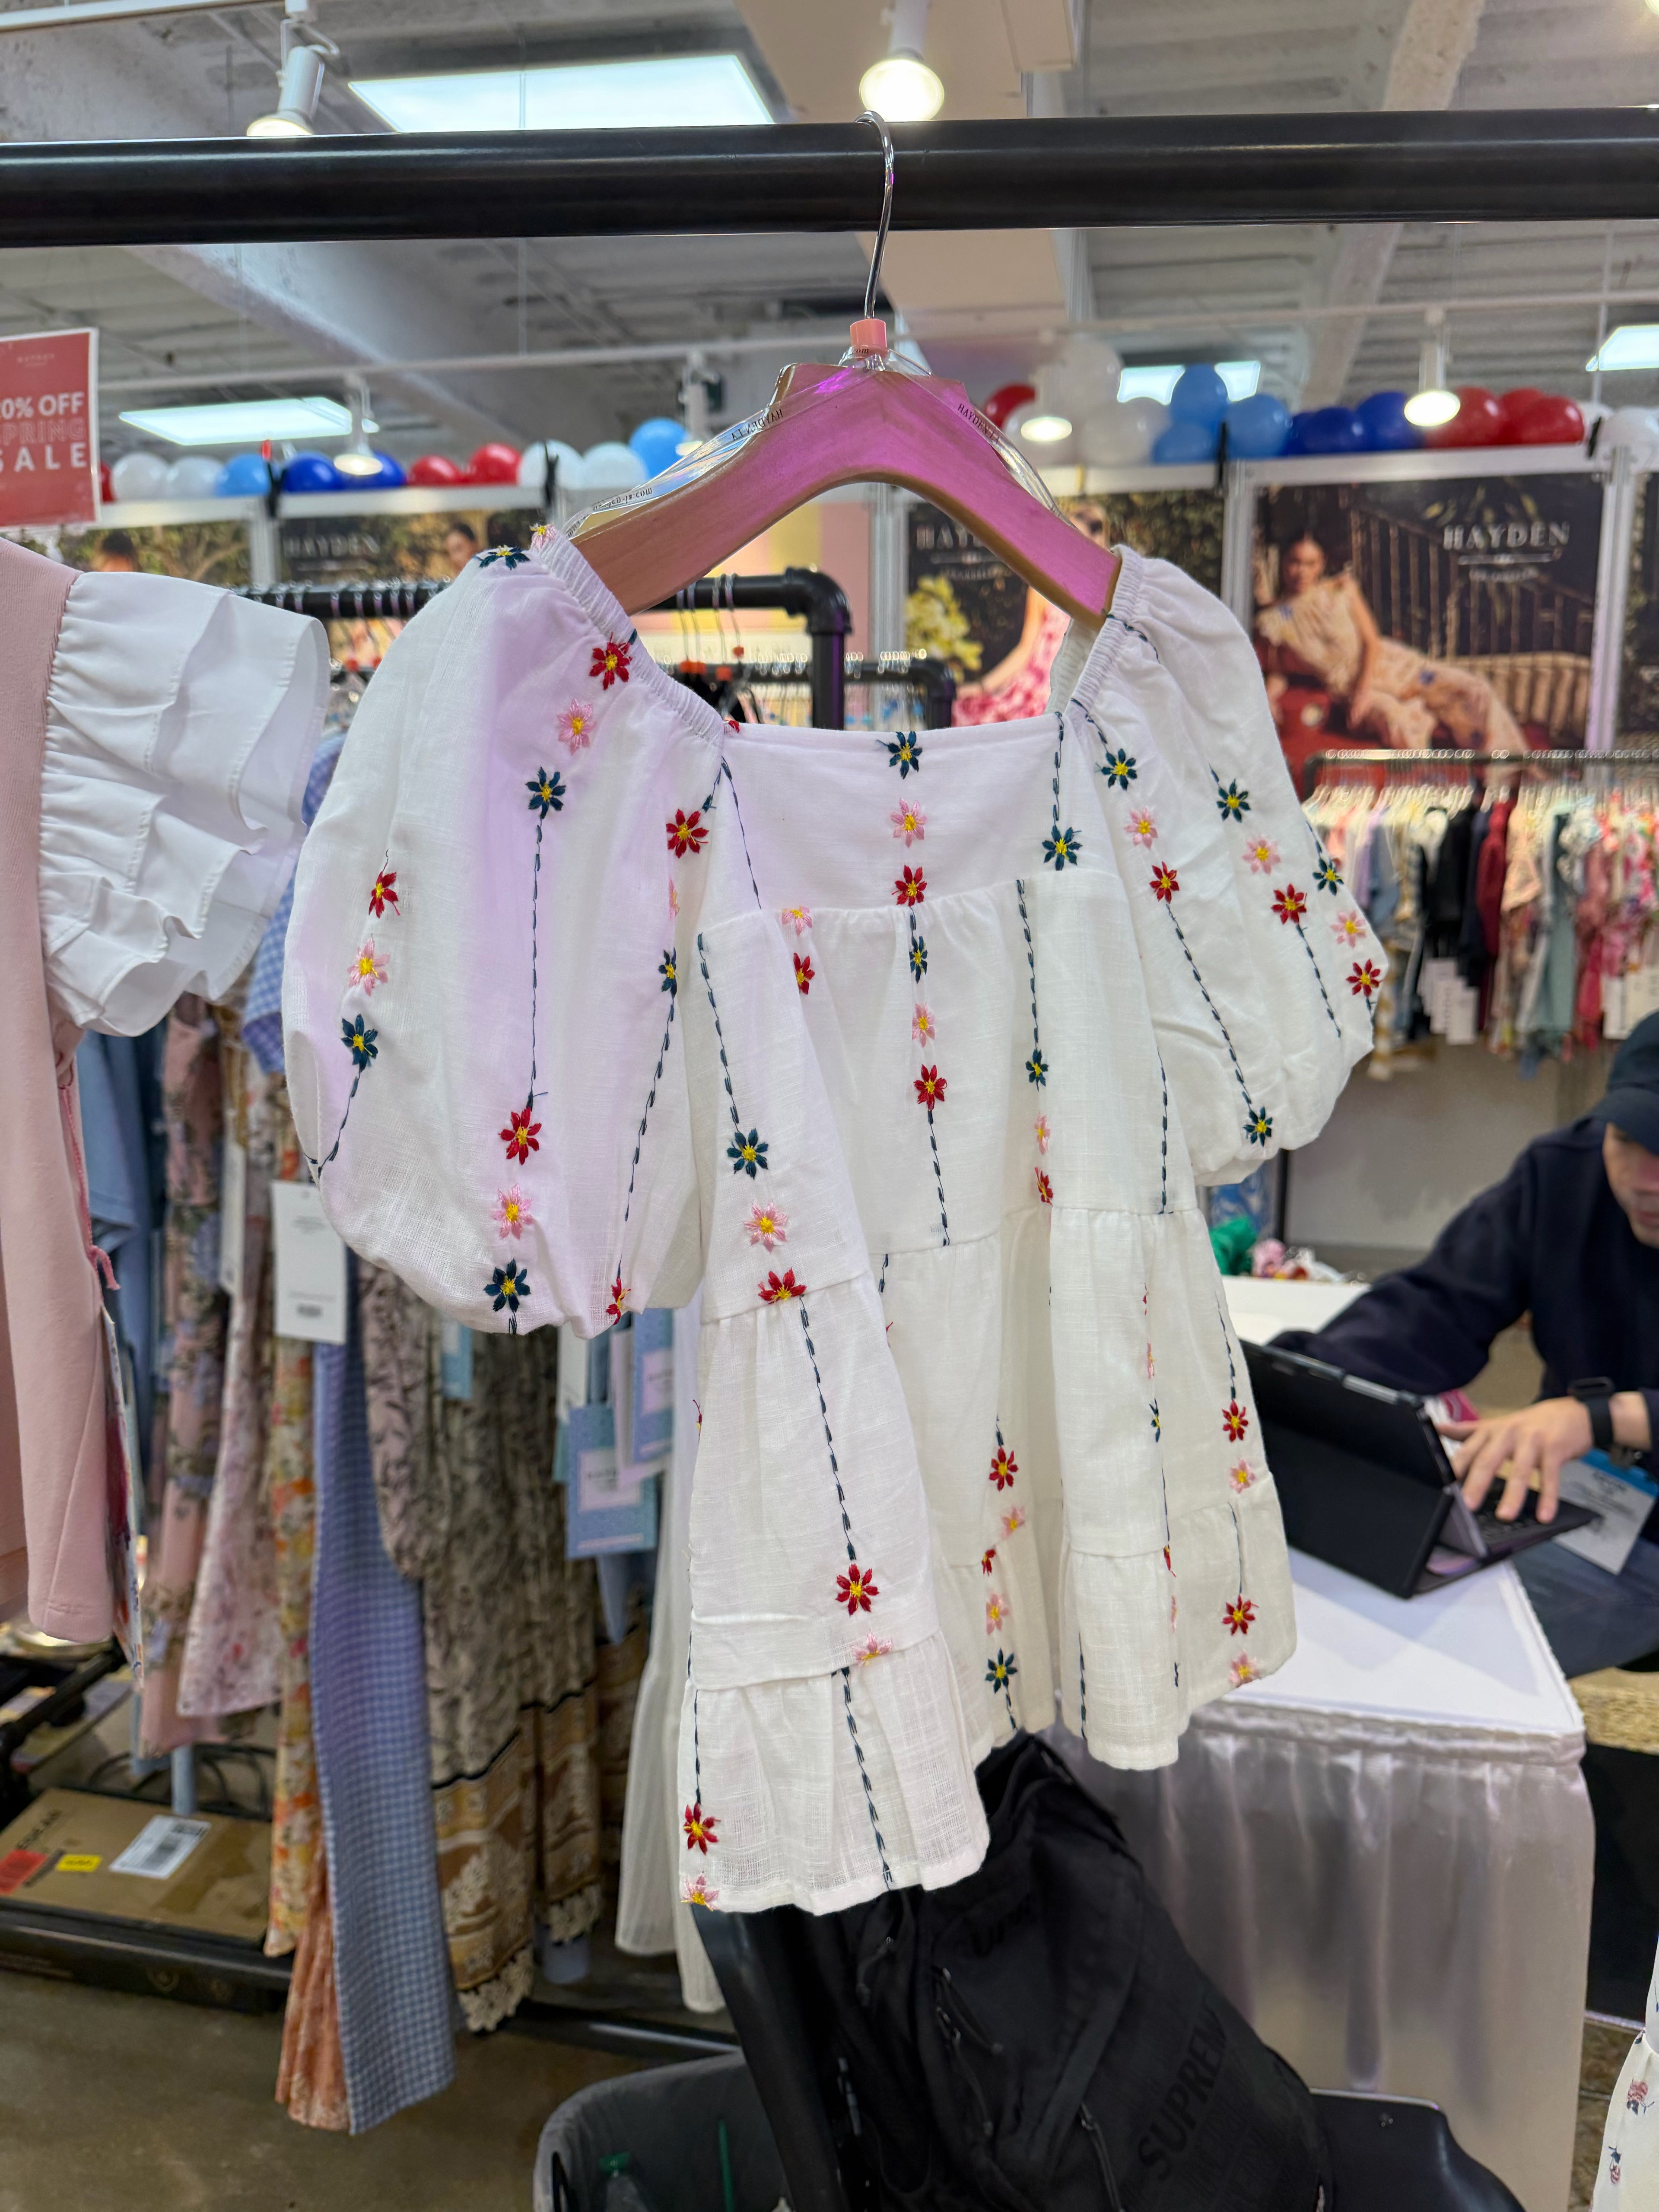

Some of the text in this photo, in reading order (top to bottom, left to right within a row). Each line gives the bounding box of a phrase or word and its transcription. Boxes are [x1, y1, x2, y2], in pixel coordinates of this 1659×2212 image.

[0, 391, 85, 420] 0% OFF
[1, 417, 84, 446] PRING
[0, 442, 86, 473] ALE
[916, 521, 985, 550] HAY
[1443, 520, 1570, 550] HAYDEN
